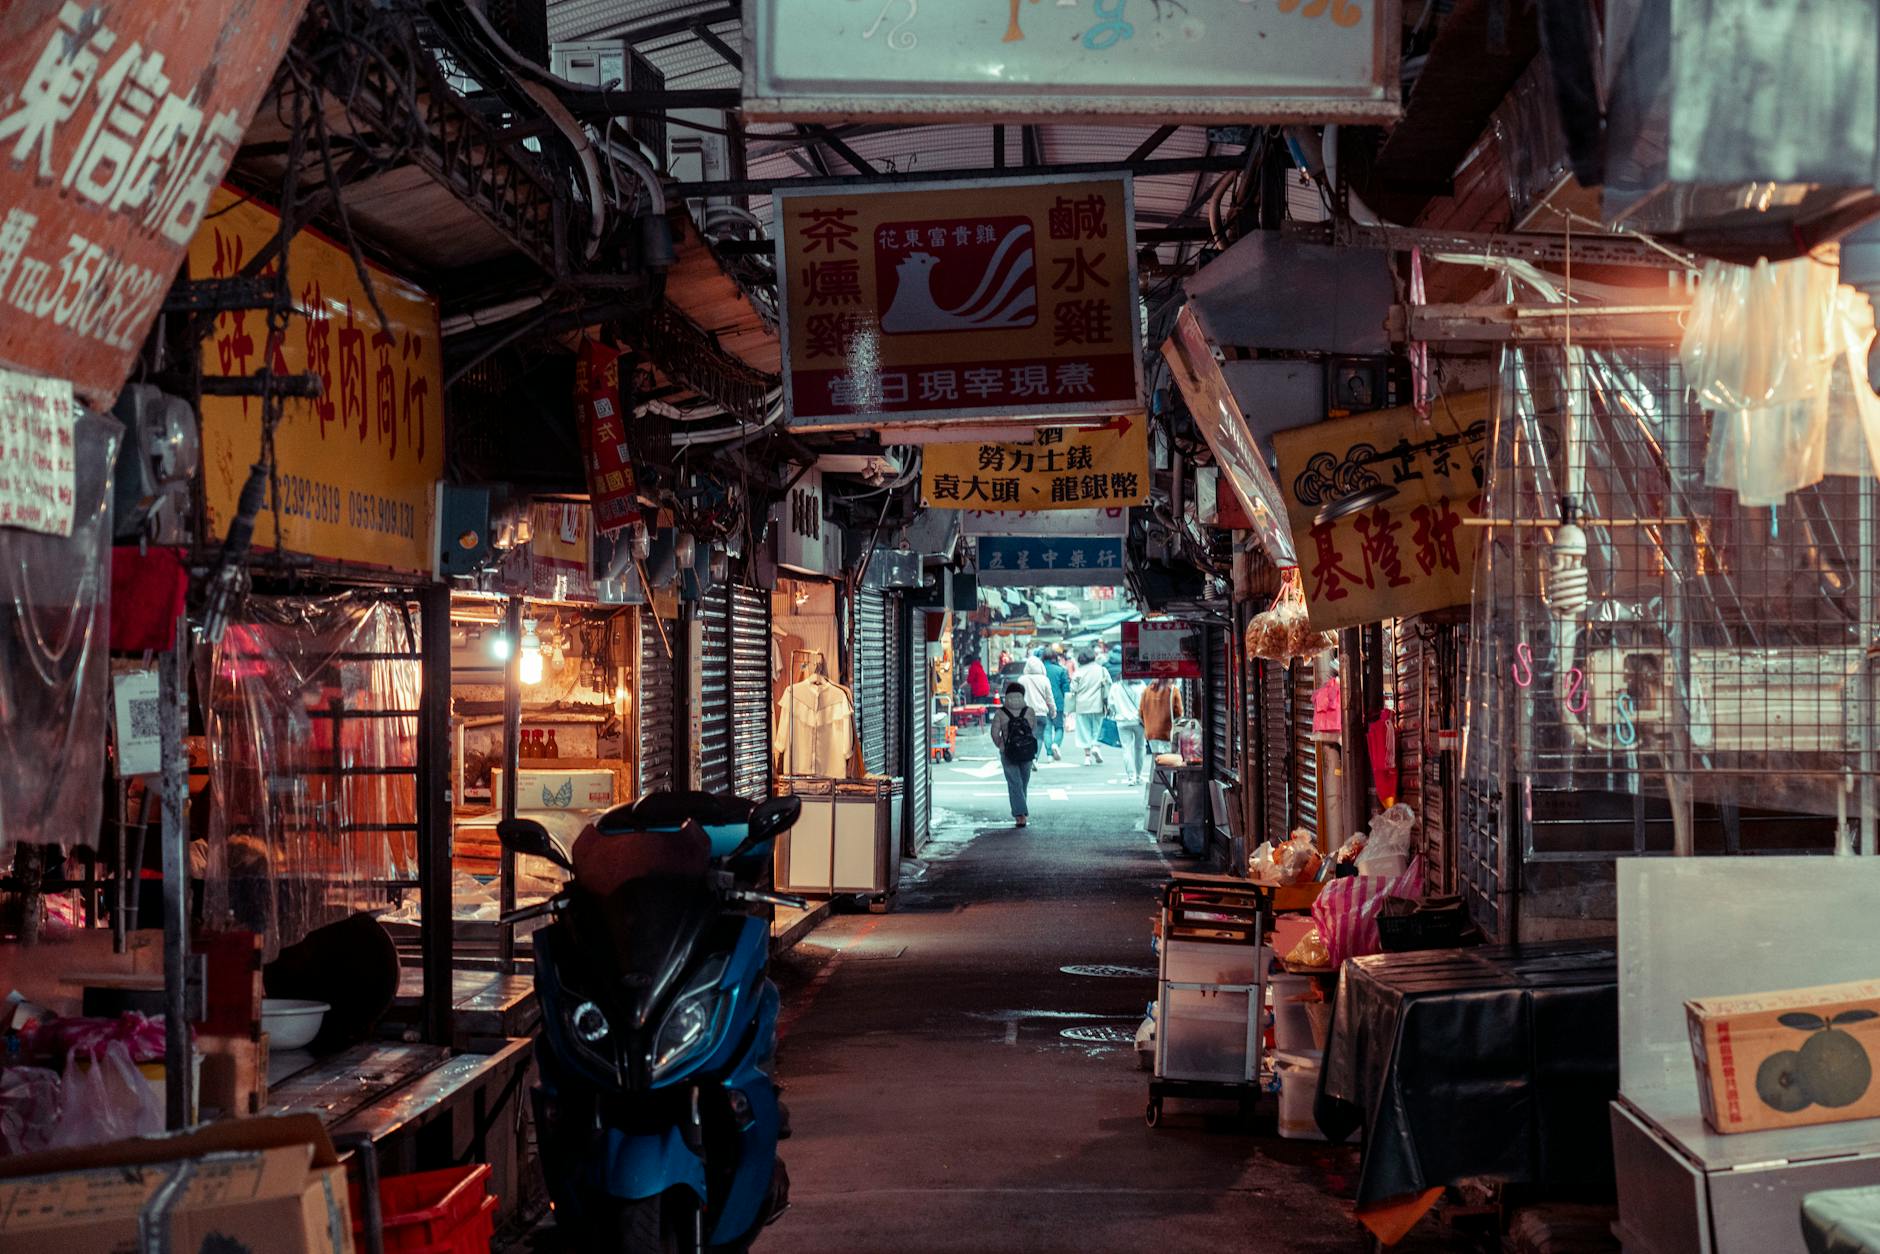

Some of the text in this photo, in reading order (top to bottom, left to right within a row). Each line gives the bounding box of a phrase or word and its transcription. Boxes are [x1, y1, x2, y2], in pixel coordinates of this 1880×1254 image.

[879, 224, 996, 250] 花東富貴雞
[1047, 194, 1114, 347] 鹹水雞
[978, 444, 1093, 473] 勞力士錶
[932, 472, 1138, 503] 袁大頭、龍銀幣
